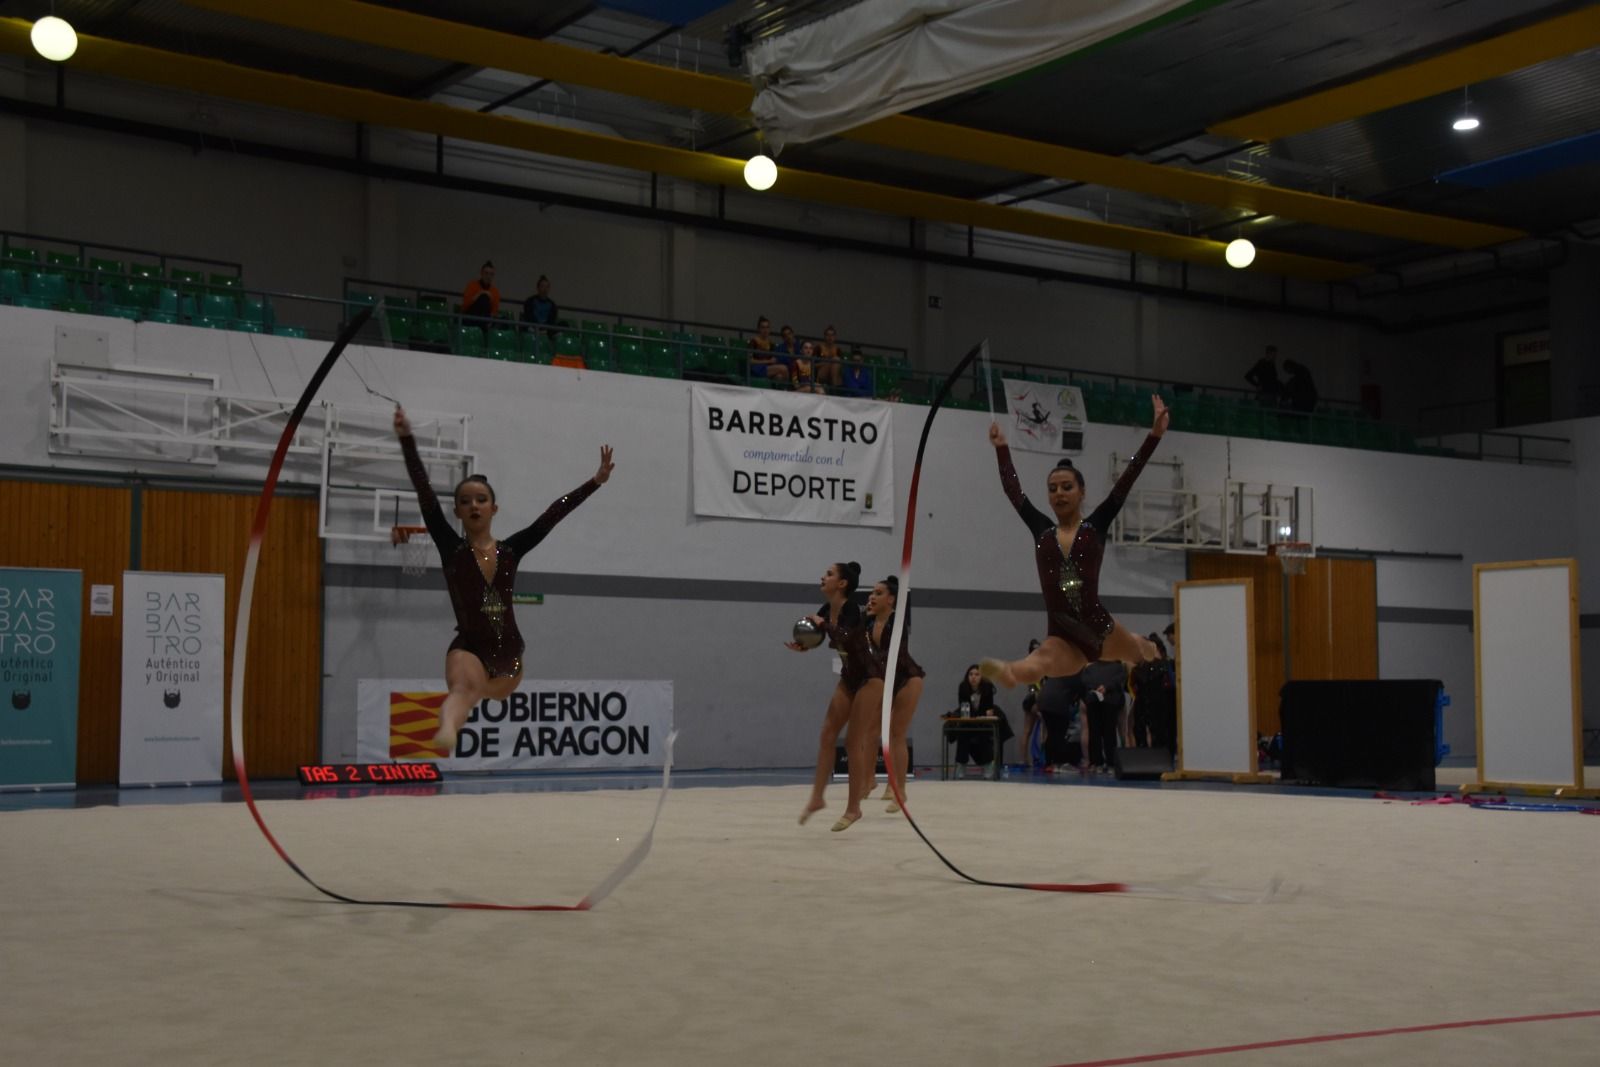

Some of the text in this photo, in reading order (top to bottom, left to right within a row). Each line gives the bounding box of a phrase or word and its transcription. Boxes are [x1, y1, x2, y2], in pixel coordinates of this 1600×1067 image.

[708, 407, 878, 444] BARBASTRO
[743, 445, 845, 466] comprometido con el
[733, 470, 857, 501] DEPORTE
[146, 591, 201, 612] BAR
[146, 614, 202, 634] BAS
[146, 635, 203, 656] TRO
[0, 657, 54, 670] uténtico
[145, 657, 201, 670] Auténtico
[3, 670, 53, 686] Original
[145, 670, 200, 685] y Original
[455, 726, 649, 758] DE ARAGON
[301, 764, 438, 782] TAS 2 CINTAS
